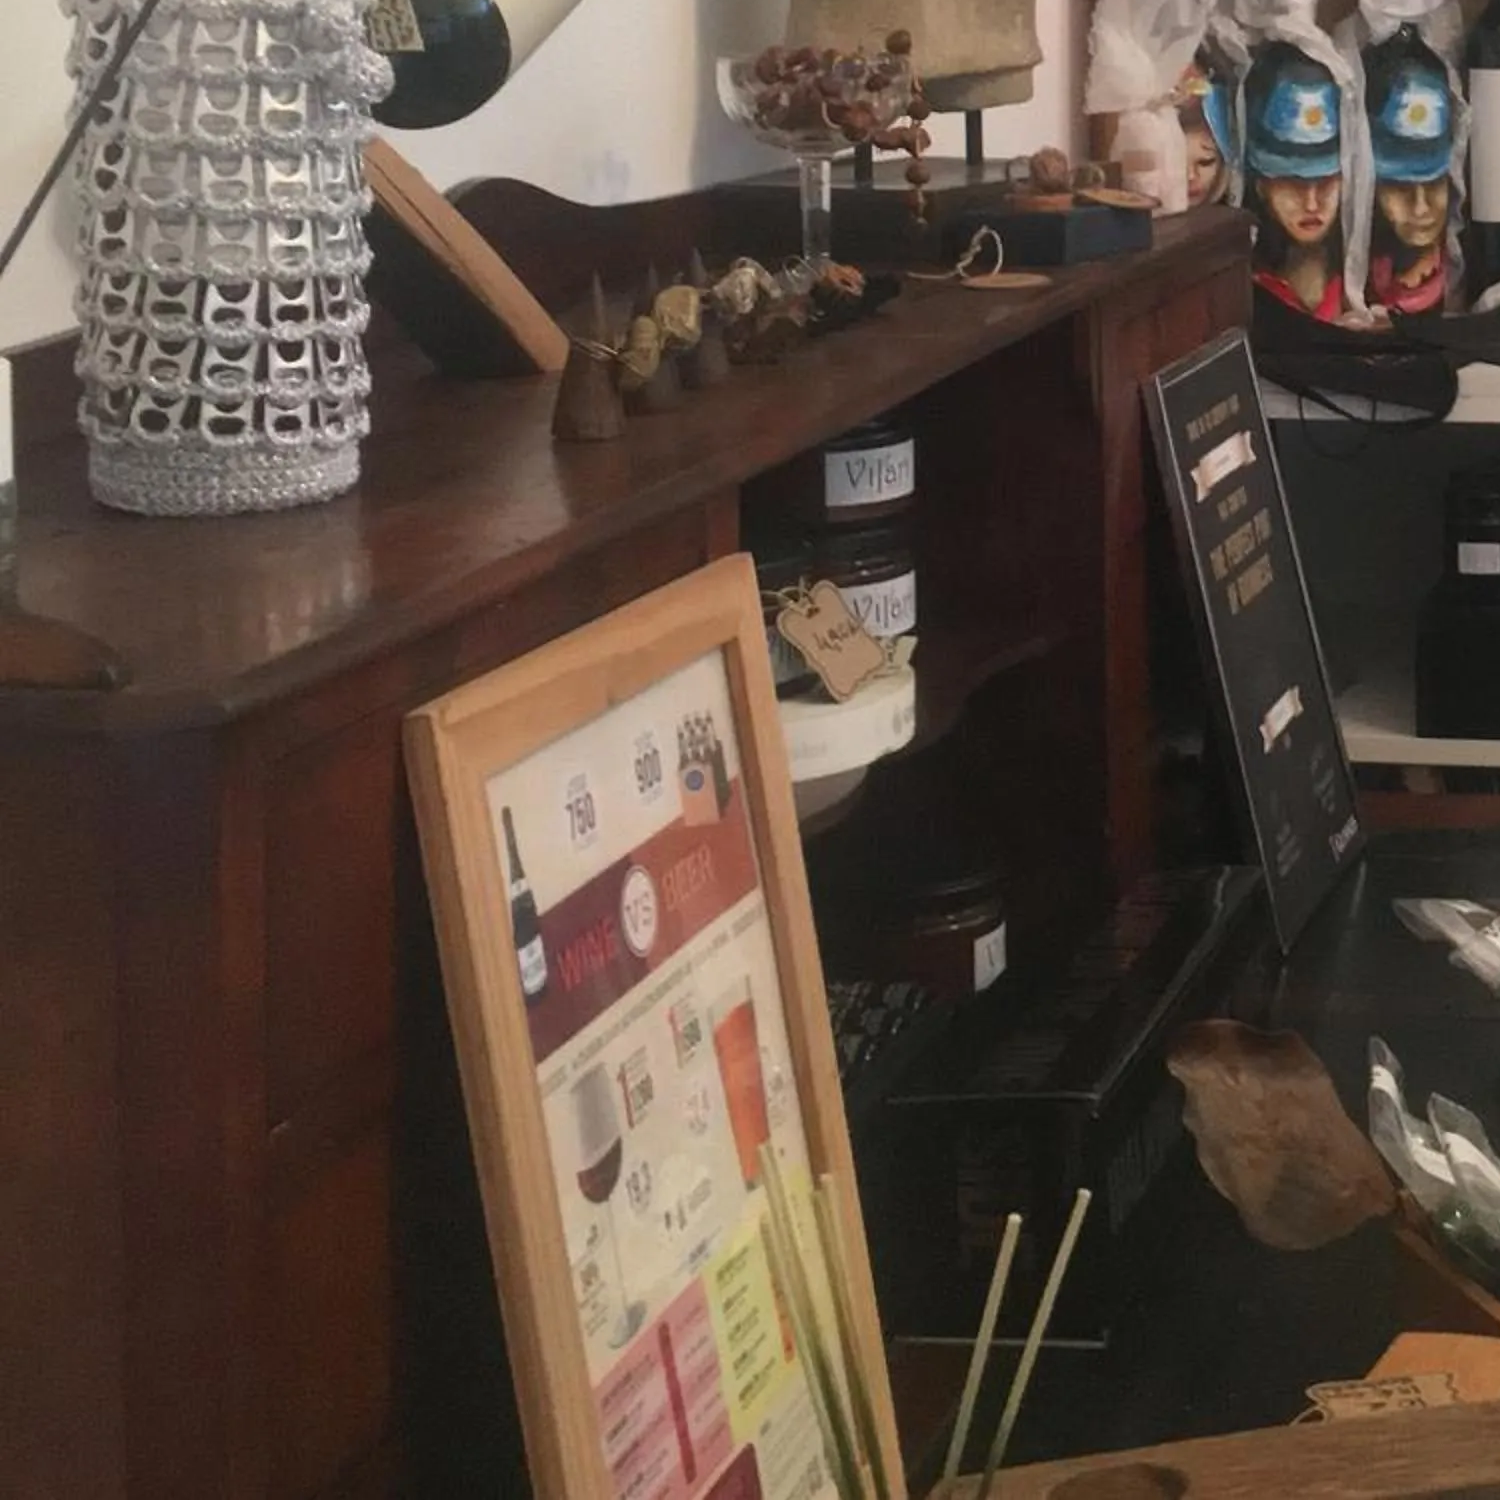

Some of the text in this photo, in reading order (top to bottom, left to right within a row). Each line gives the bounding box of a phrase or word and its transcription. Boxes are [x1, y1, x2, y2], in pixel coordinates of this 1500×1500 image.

[565, 790, 597, 842] 750
[556, 914, 618, 993] WINE
[661, 843, 716, 912] BEER
